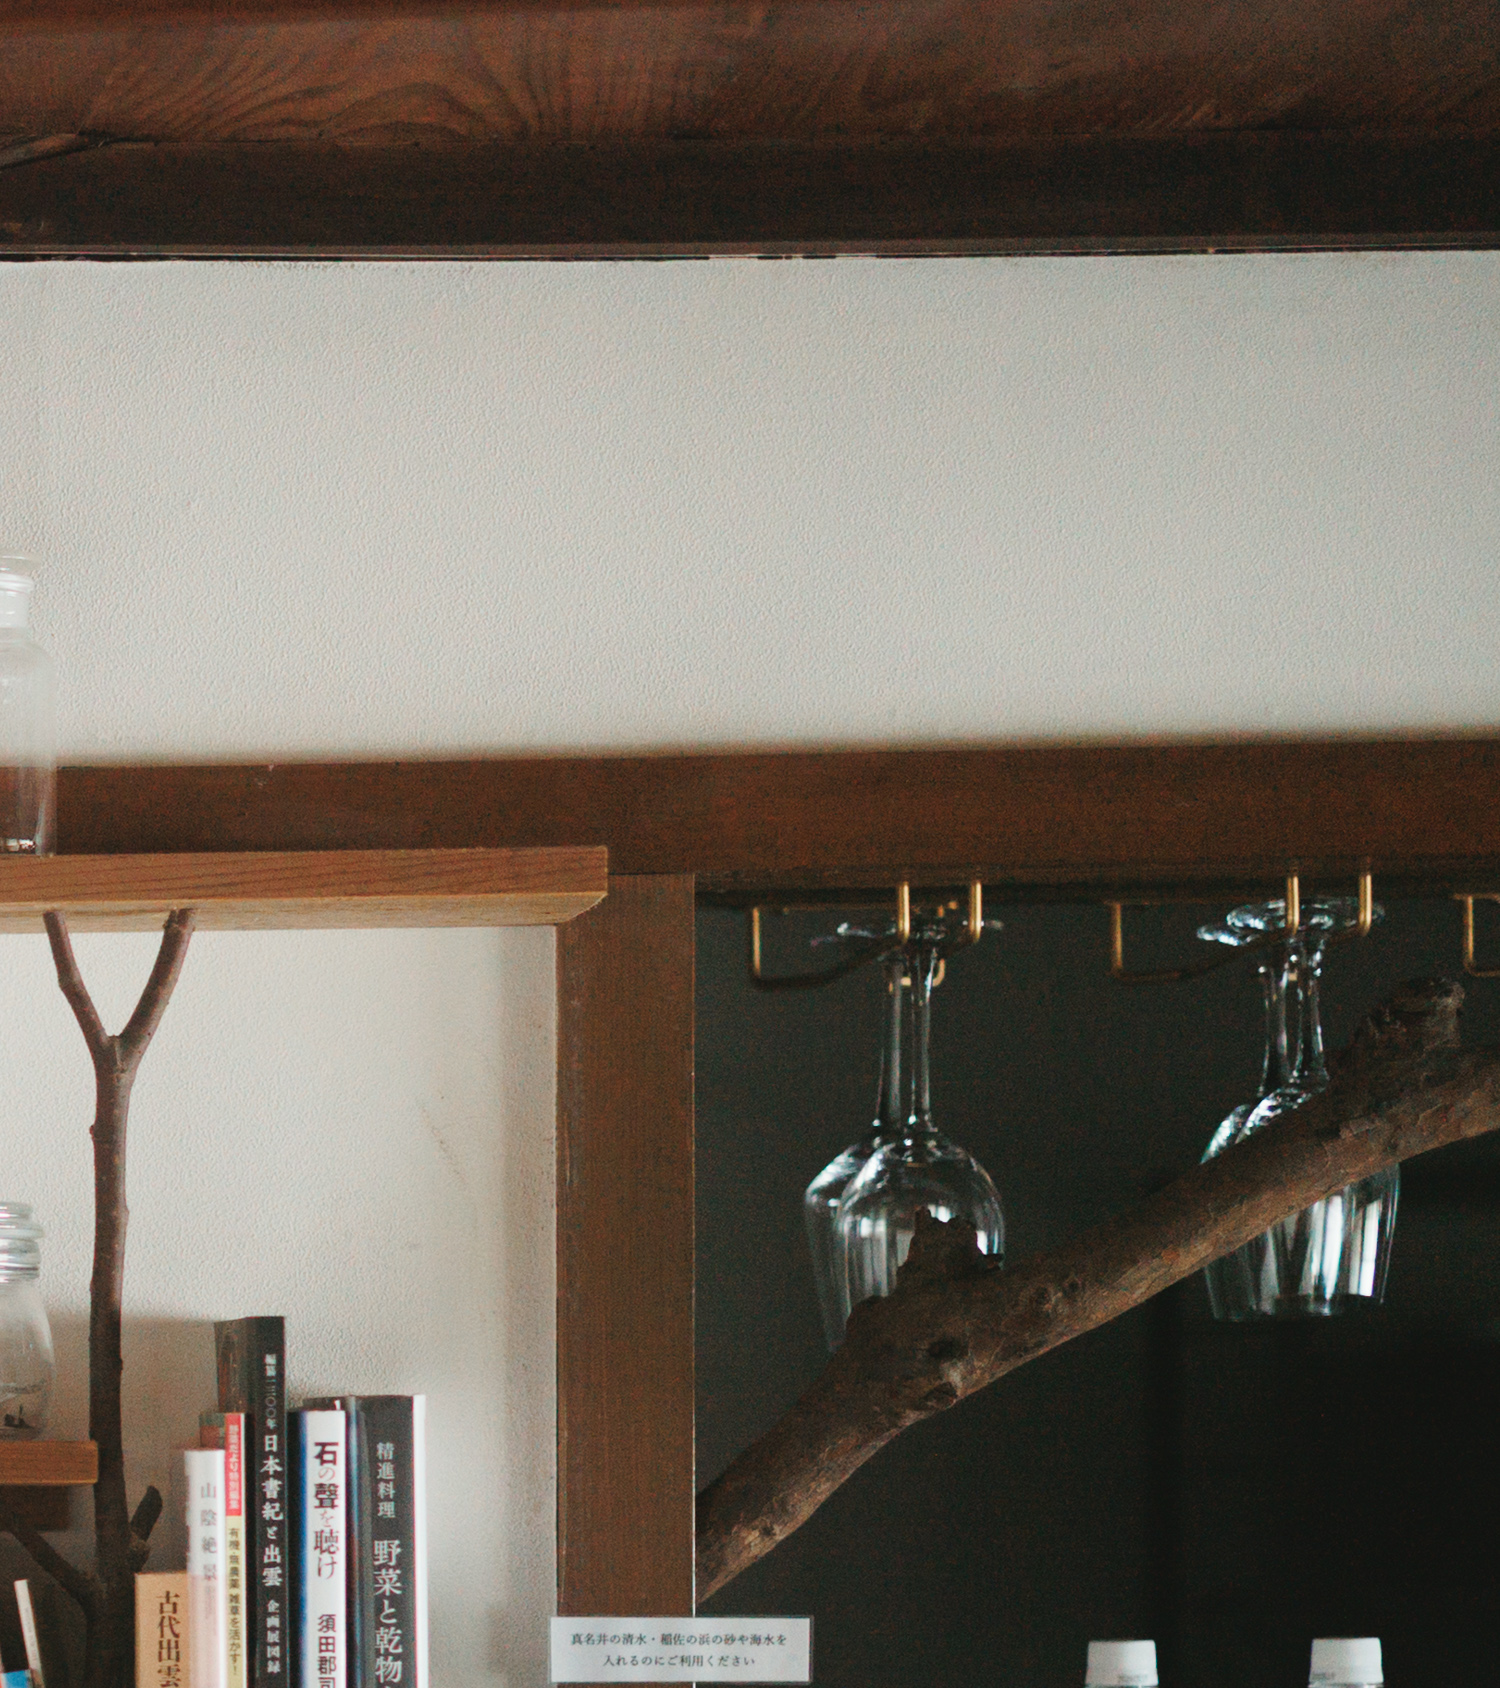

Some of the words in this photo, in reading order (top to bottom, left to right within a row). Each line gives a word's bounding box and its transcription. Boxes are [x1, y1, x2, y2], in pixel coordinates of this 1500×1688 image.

[260, 1434, 284, 1587] 日本書紀と出雲
[313, 1441, 340, 1580] 石の聲を聴け
[376, 1441, 396, 1519] 精進料理
[602, 1655, 756, 1667] 入れるのにご利用ください
